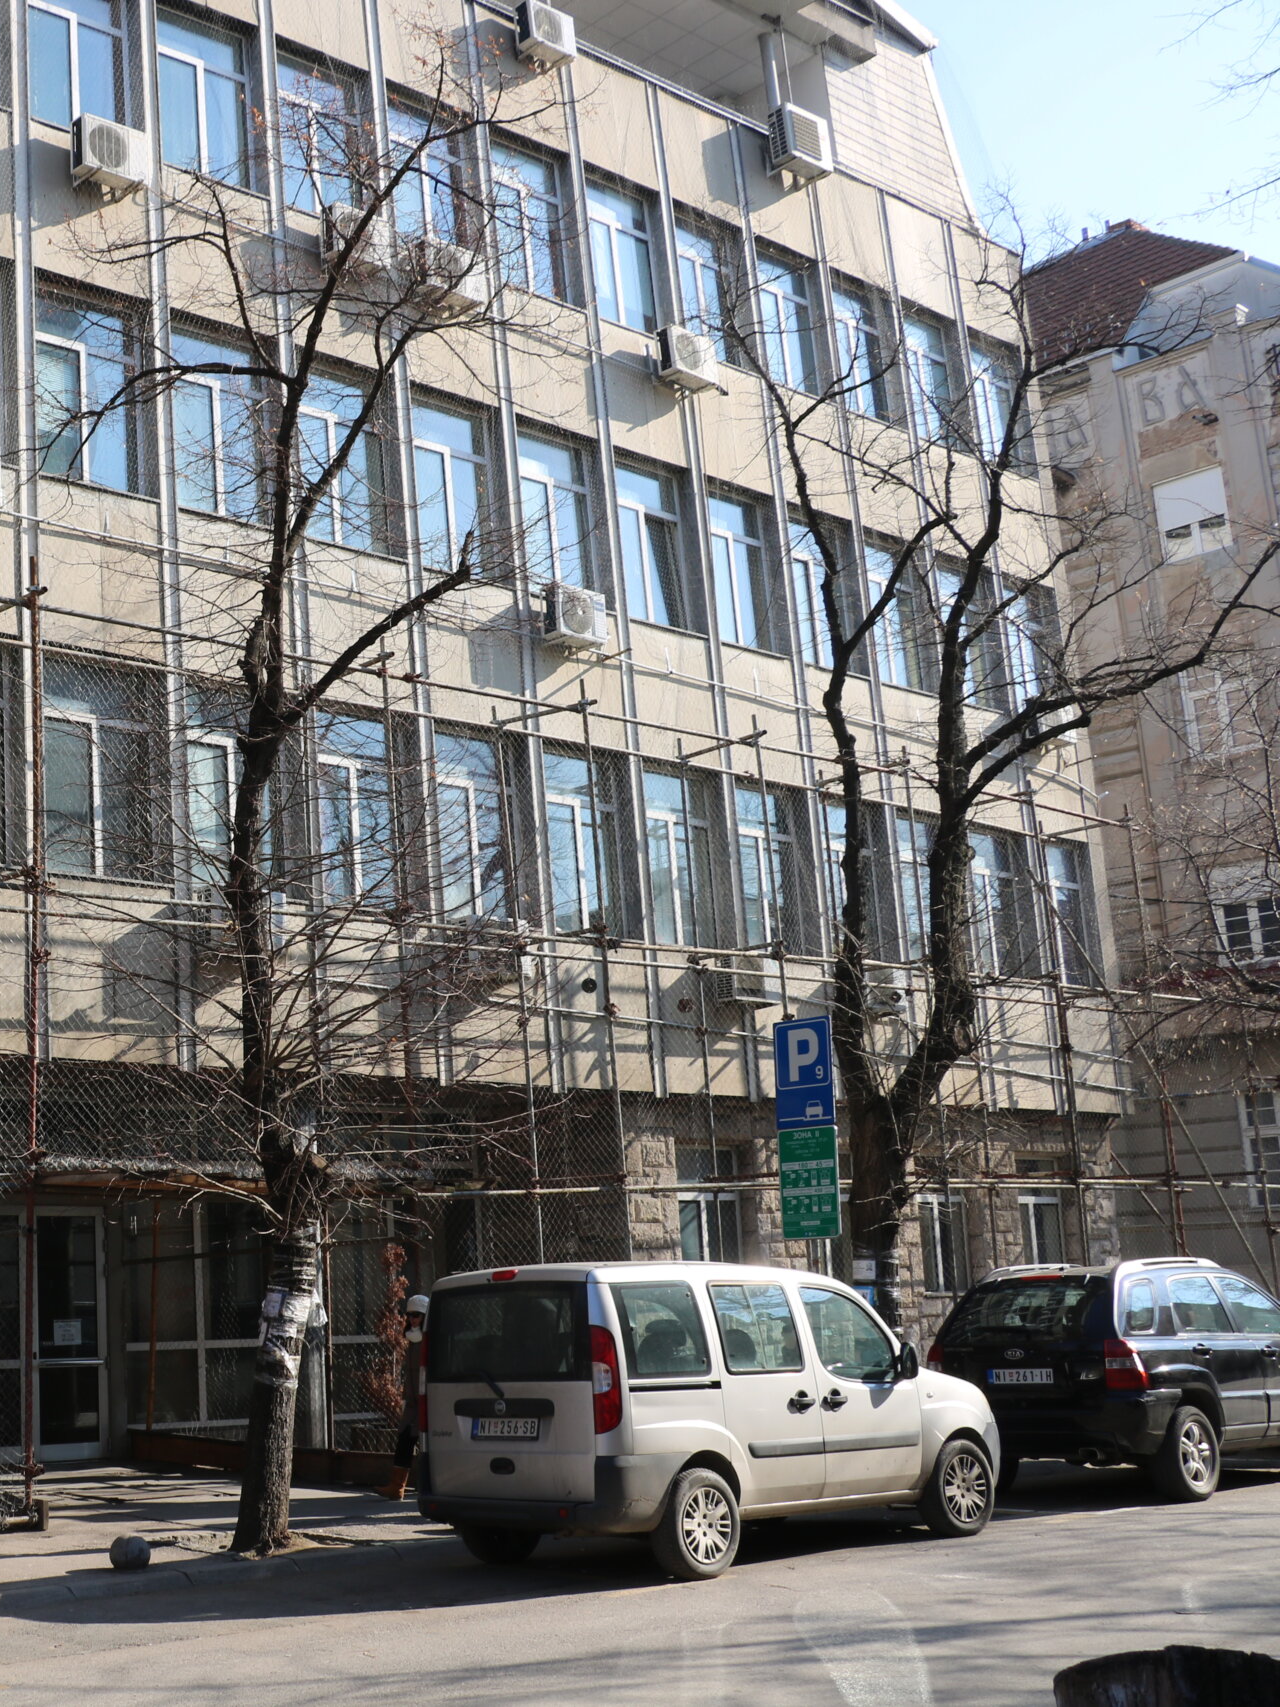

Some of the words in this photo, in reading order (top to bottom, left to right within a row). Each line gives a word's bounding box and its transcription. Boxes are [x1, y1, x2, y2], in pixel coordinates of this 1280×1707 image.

[787, 1027, 819, 1082] P
[815, 1065, 824, 1079] 9
[792, 1130, 812, 1140] ЗОНА
[994, 1371, 1006, 1382] NI
[479, 1421, 491, 1435] NI
